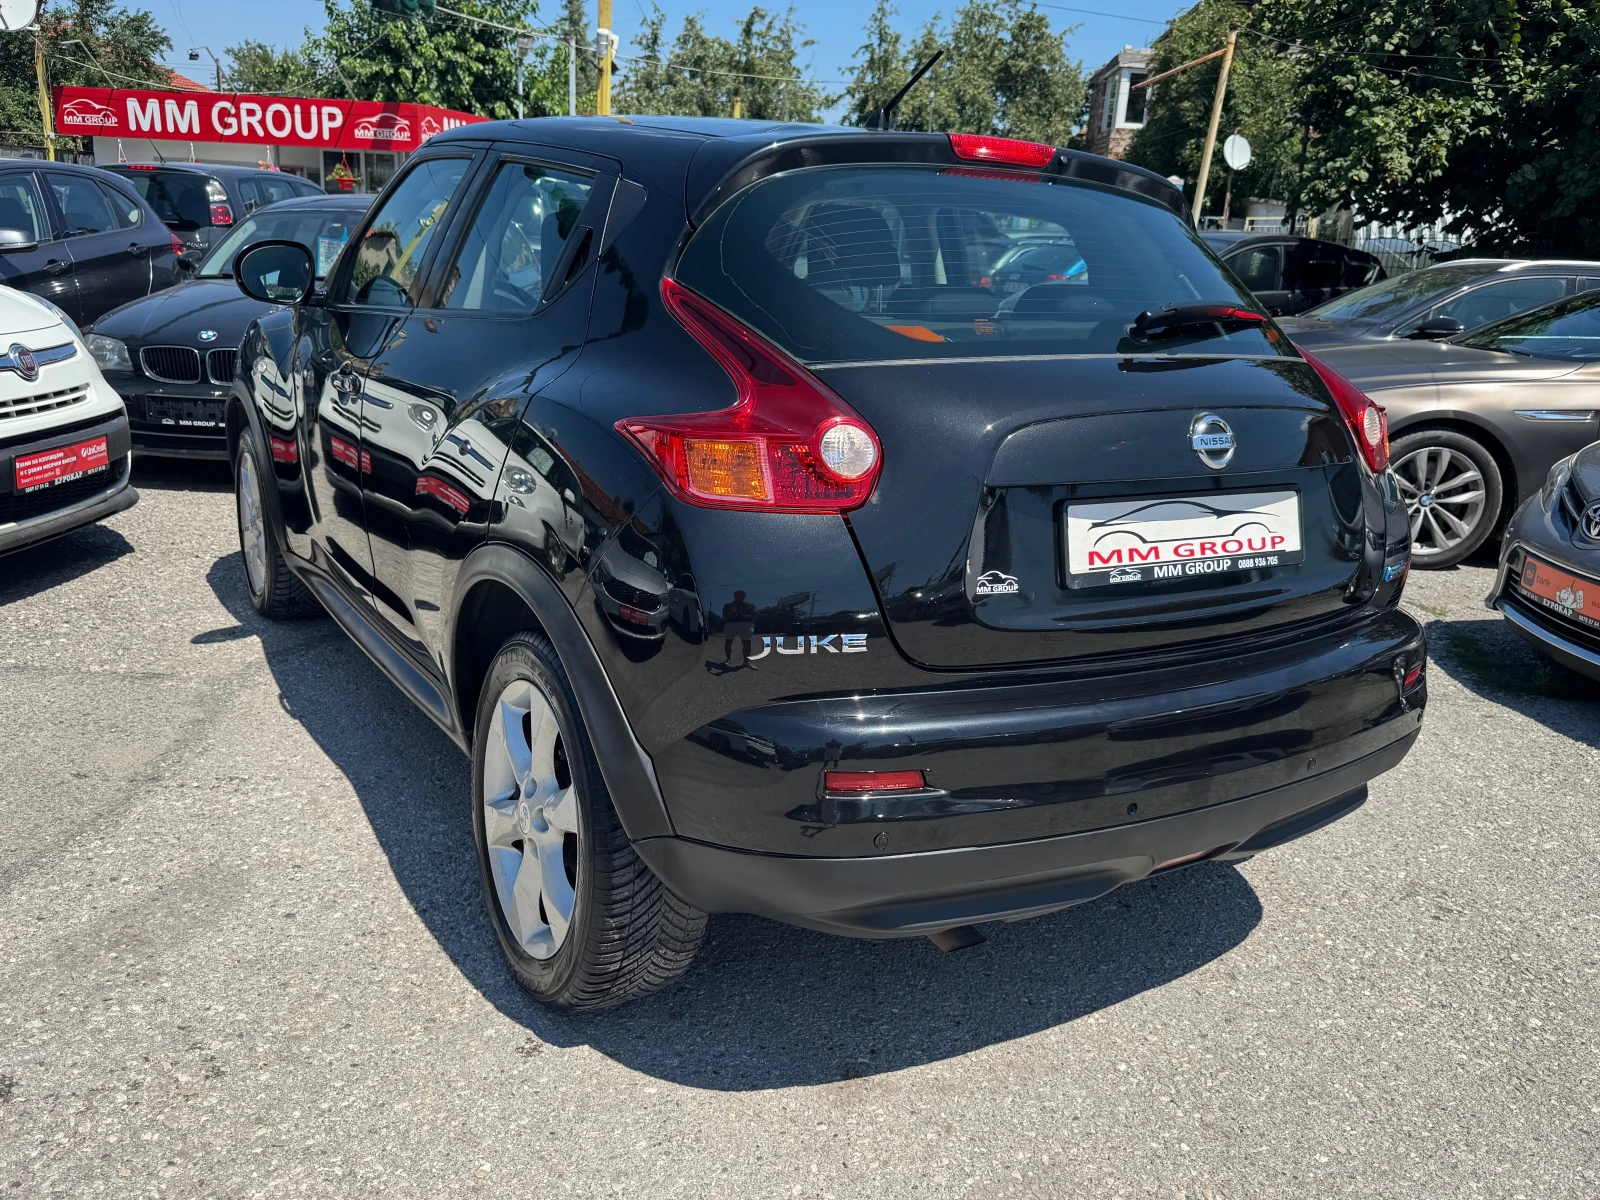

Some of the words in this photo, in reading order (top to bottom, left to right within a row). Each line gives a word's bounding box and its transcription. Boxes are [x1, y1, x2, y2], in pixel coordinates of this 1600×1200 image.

[64, 115, 82, 124] MM
[85, 116, 118, 125] GROUP
[126, 97, 200, 134] MM
[211, 101, 343, 141] GROUP
[354, 129, 375, 138] MM
[376, 130, 411, 139] GROUP
[86, 442, 107, 456] UniCredit
[1200, 436, 1235, 446] NISSAN
[1088, 546, 1160, 566] MM
[1172, 535, 1285, 558] GROUP
[1154, 564, 1182, 579] MM
[1185, 559, 1232, 575] GROUP
[1238, 558, 1254, 569] 0888
[1254, 557, 1266, 567] 936
[1267, 556, 1278, 565] 705
[1543, 598, 1573, 617] ЕУРОКАР
[747, 634, 868, 660] JUKE
